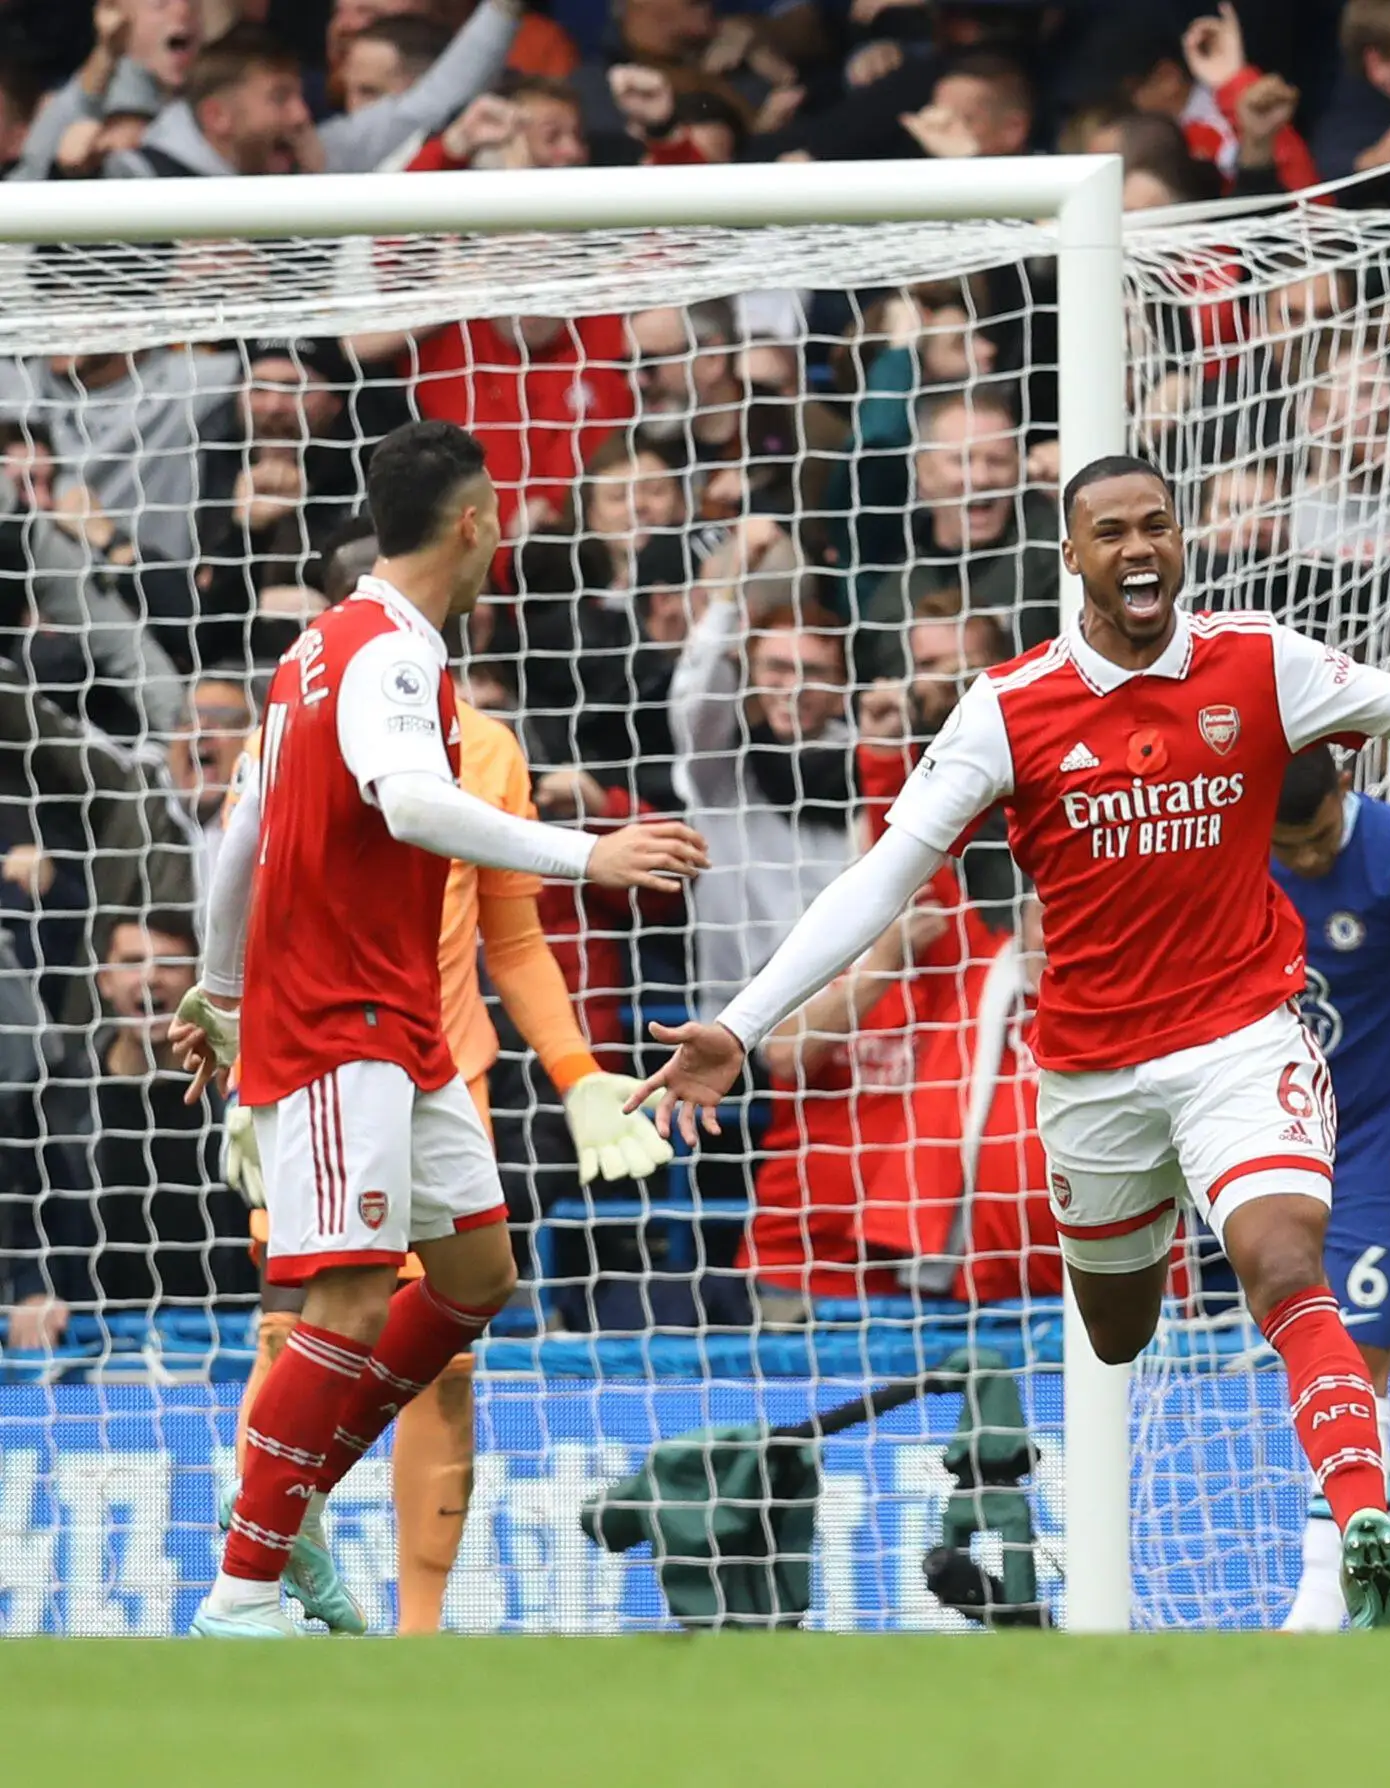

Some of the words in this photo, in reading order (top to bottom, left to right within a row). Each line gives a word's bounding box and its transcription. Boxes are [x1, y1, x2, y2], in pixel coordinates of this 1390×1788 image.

[1061, 773, 1244, 830] Emirates
[1091, 826, 1131, 859] FLY
[1138, 813, 1222, 856] BETTER
[1277, 1062, 1313, 1119] 6
[1346, 1245, 1389, 1309] 6
[1312, 1403, 1371, 1430] AFC
